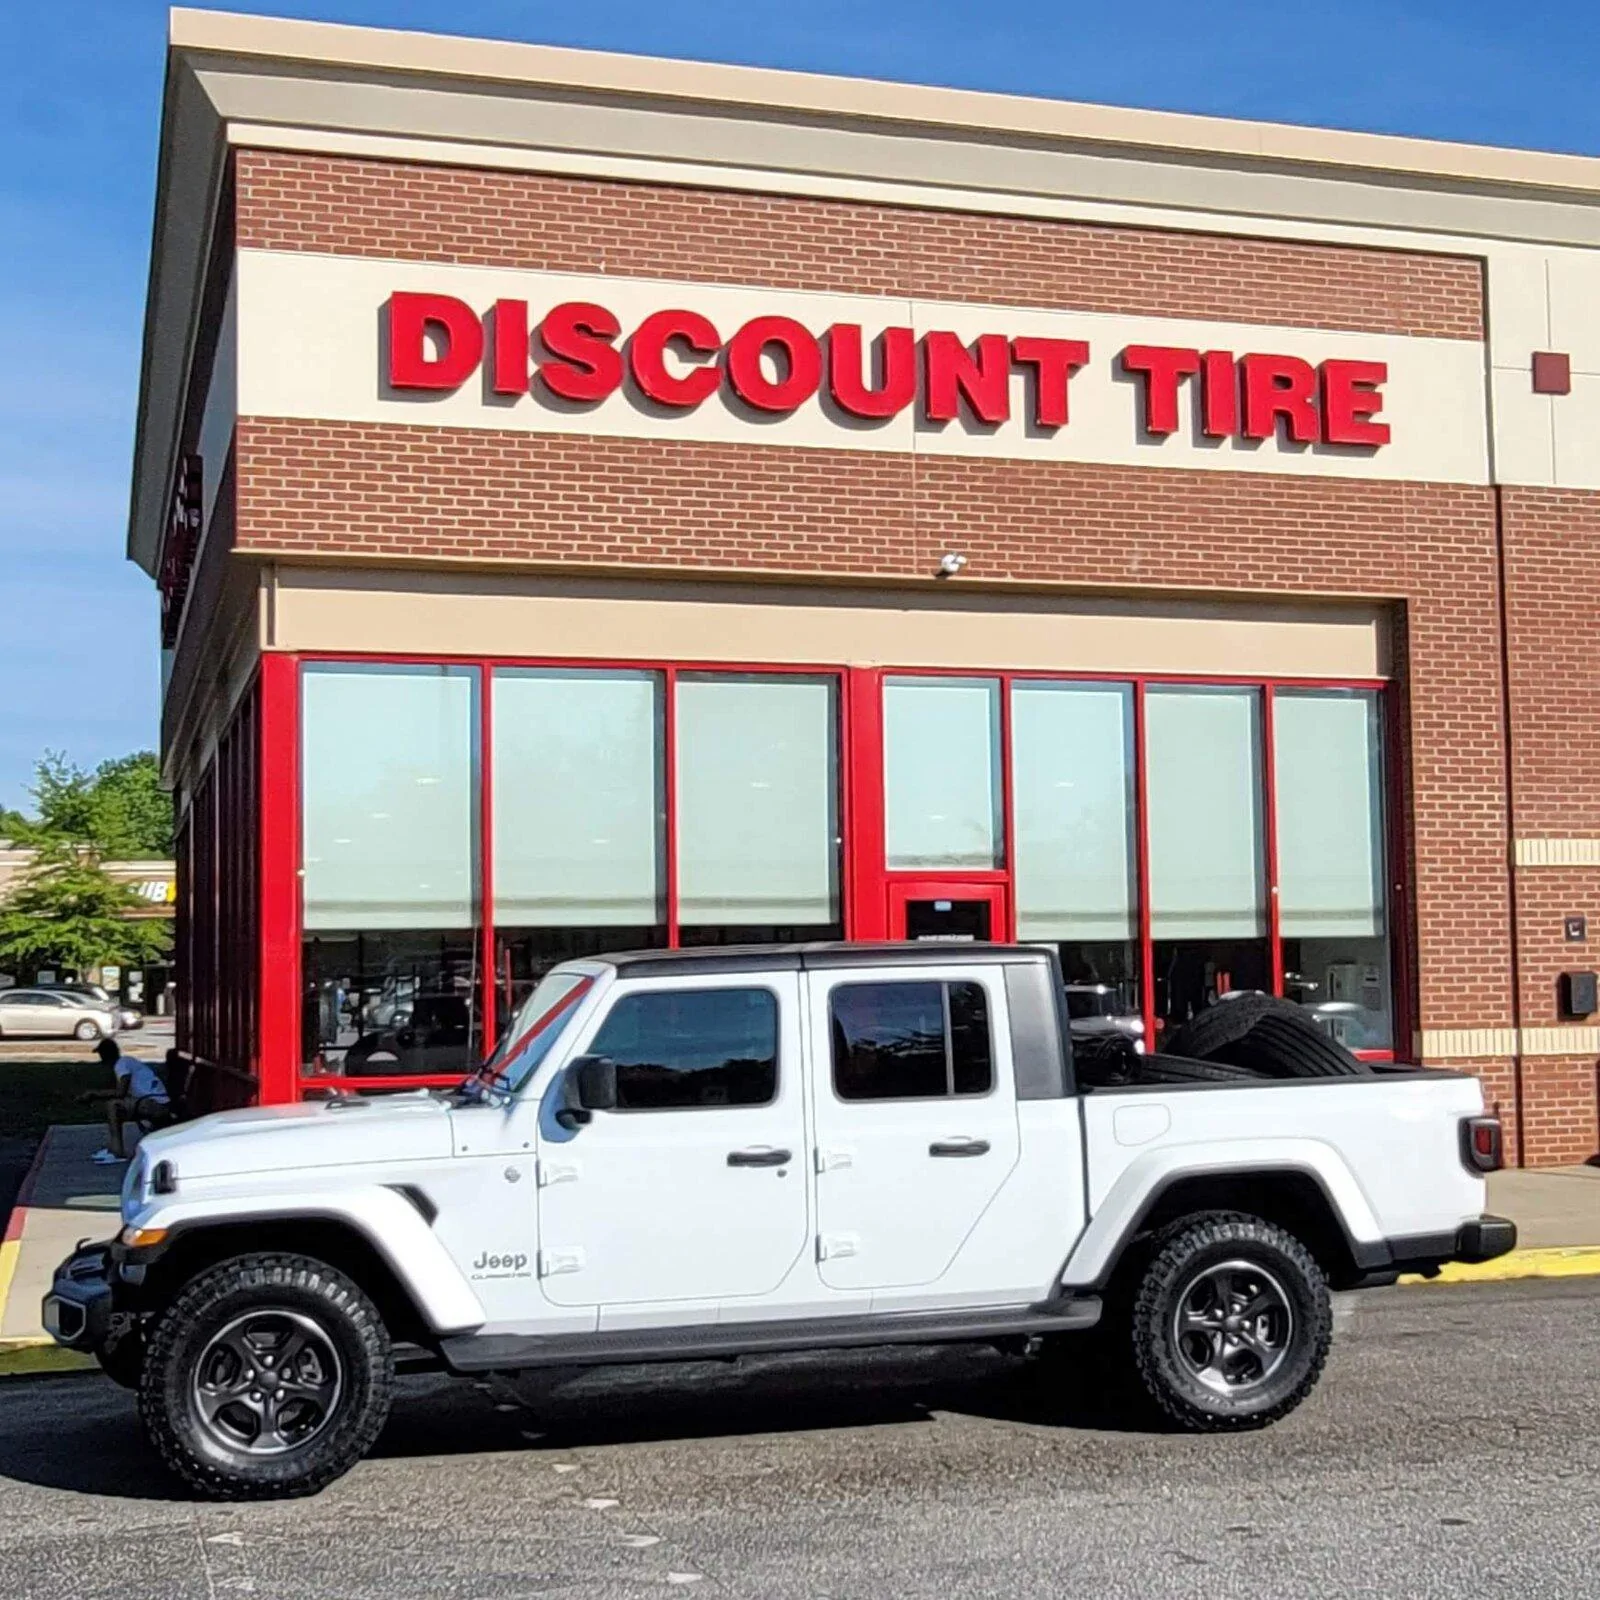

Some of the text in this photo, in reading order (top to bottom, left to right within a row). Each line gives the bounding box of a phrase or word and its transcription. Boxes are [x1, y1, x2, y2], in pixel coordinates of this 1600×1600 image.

[385, 291, 1391, 449] DISCOUNT TIRE
[473, 1251, 528, 1270] Jeep
